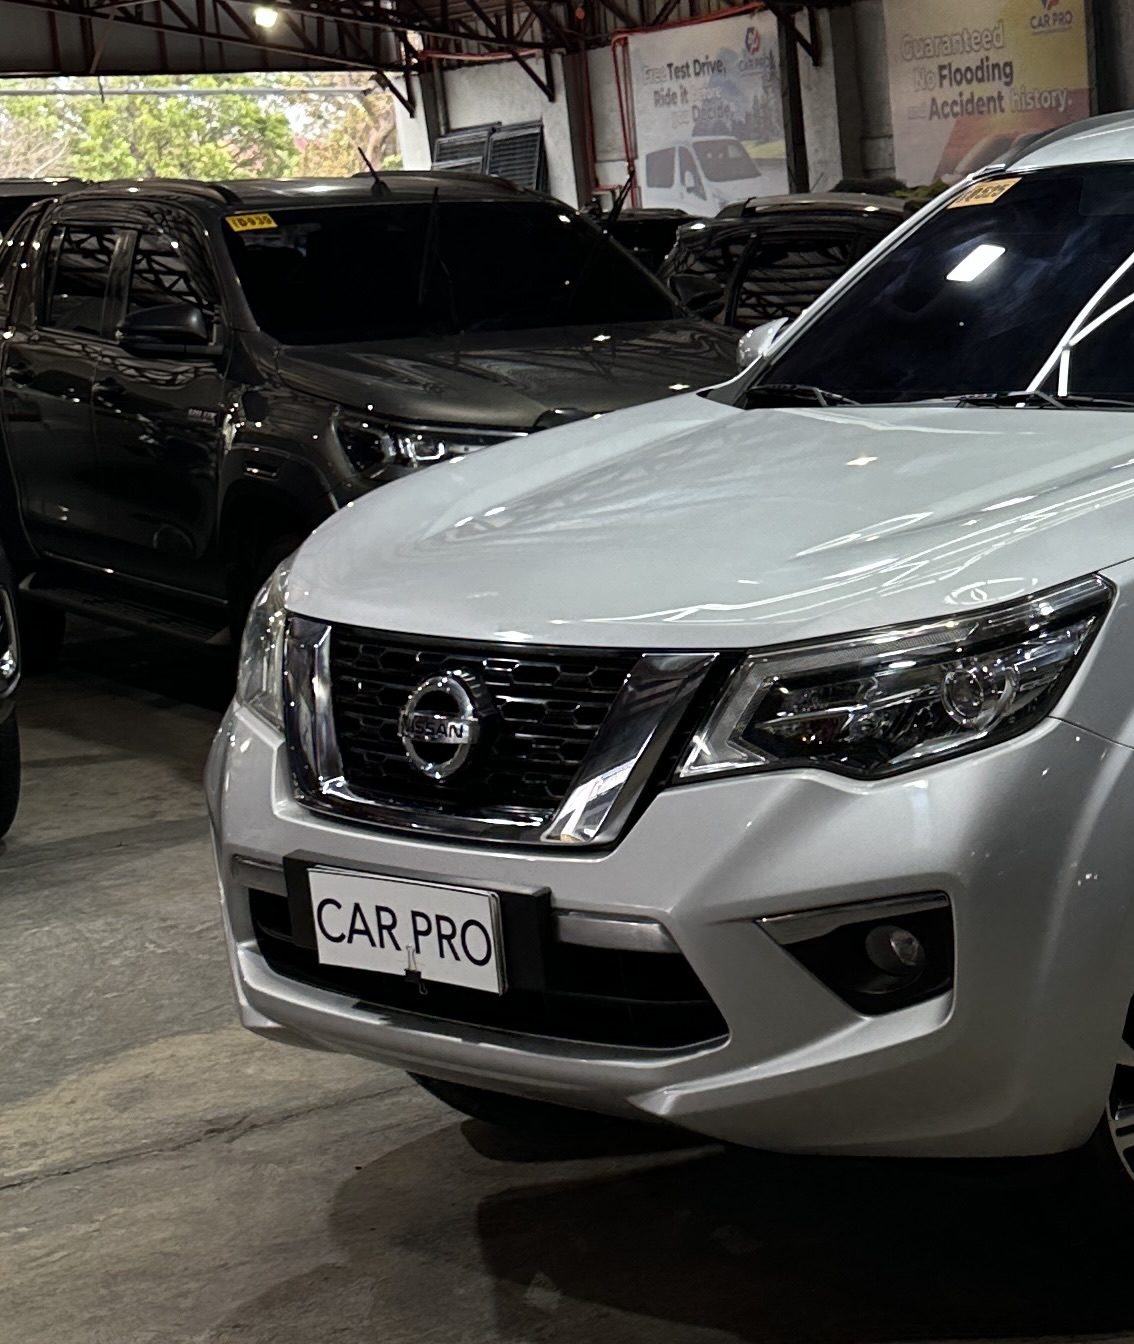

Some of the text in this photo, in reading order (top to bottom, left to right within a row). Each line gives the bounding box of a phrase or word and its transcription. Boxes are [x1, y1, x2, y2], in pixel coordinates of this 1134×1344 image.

[1030, 9, 1073, 30] CAR PRO
[901, 19, 1006, 62] Guaranteed
[666, 61, 692, 81] Test
[692, 54, 727, 77] Drive,
[913, 55, 1014, 93] No Flooding
[653, 86, 679, 107] Ride
[679, 84, 689, 104] it
[928, 90, 1006, 121] Accident
[1008, 84, 1073, 115] history.
[315, 897, 493, 967] CAR PRO
